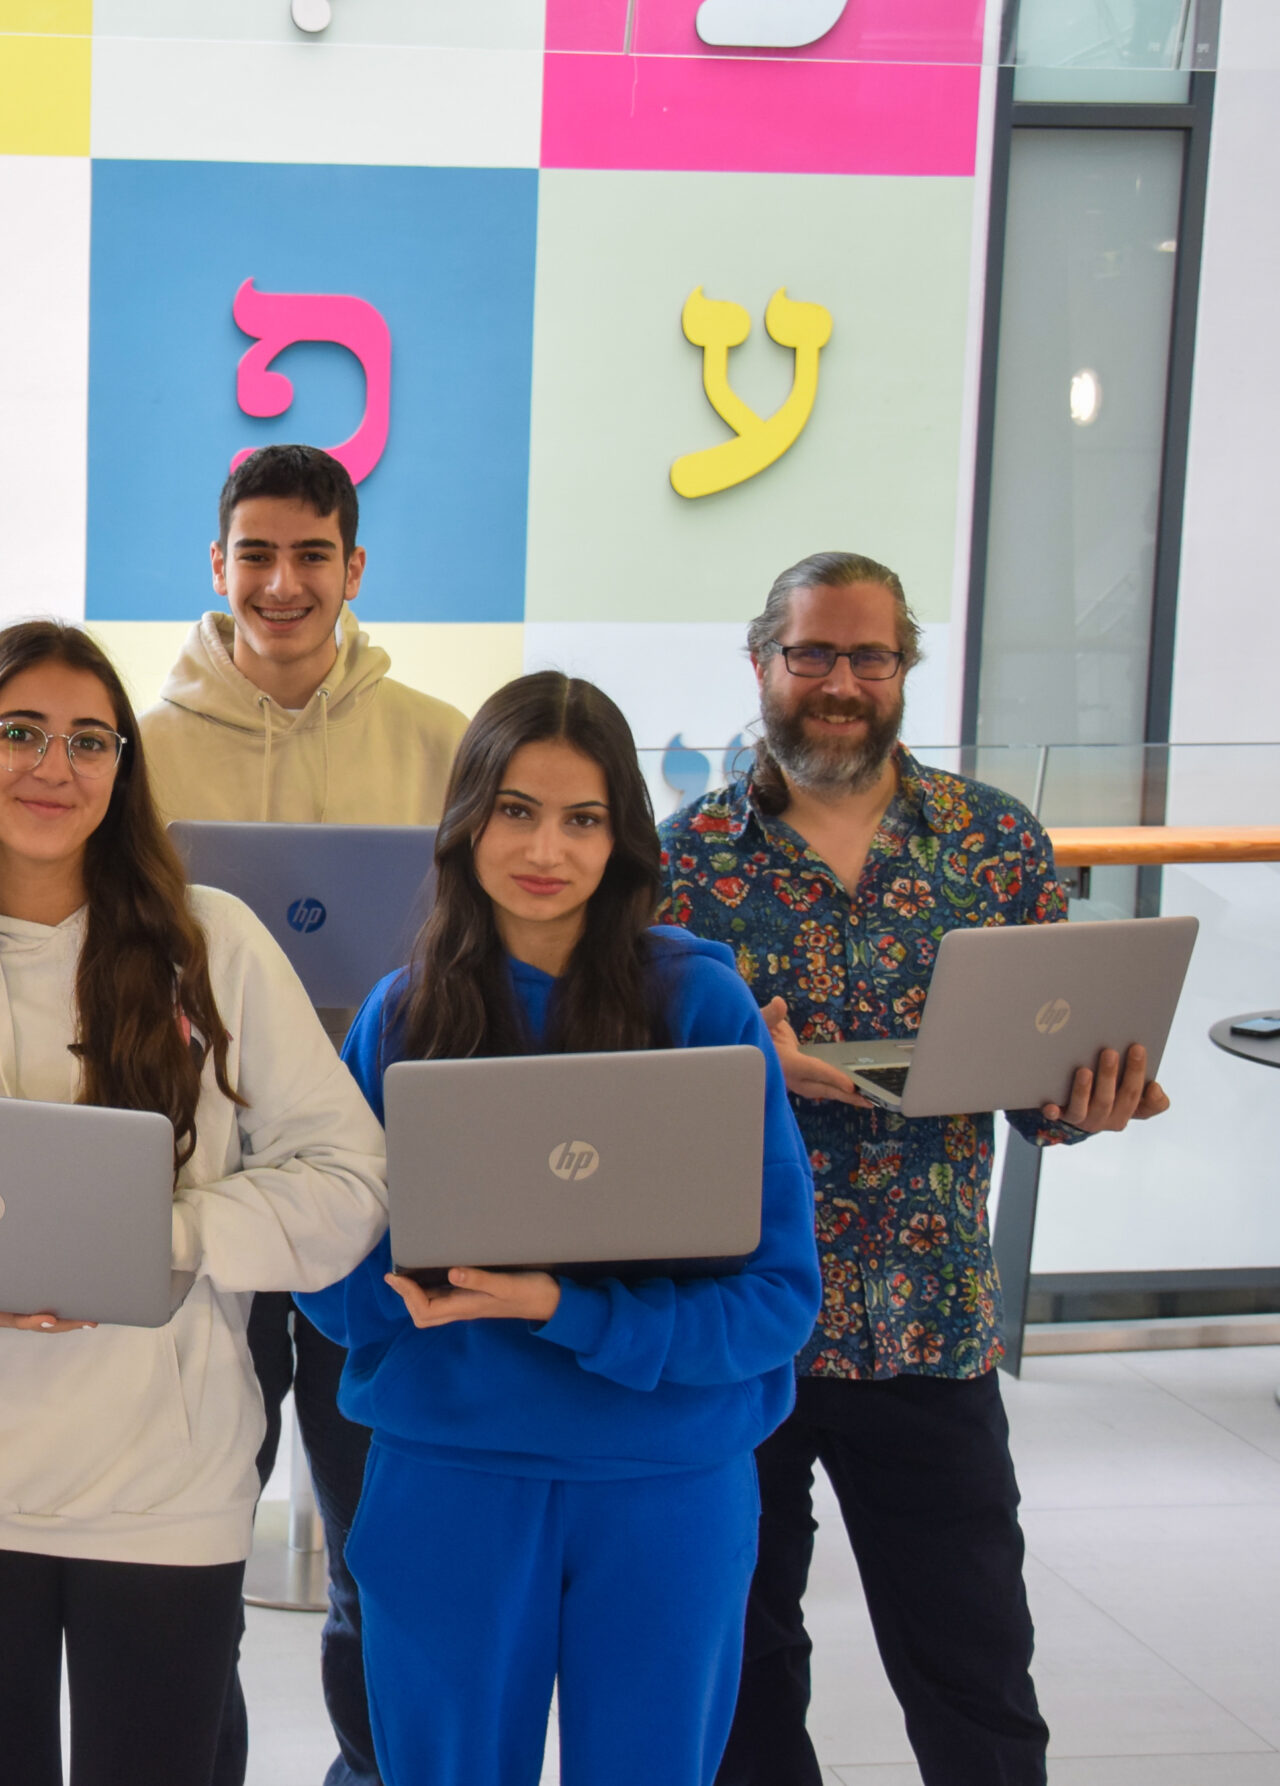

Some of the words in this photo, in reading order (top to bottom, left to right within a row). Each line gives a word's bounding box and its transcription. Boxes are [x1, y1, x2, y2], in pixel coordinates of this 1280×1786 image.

[231, 277, 392, 485] פ
[670, 285, 834, 499] ע
[291, 897, 323, 933] hp
[1037, 999, 1069, 1034] hp
[555, 1140, 595, 1181] hp
